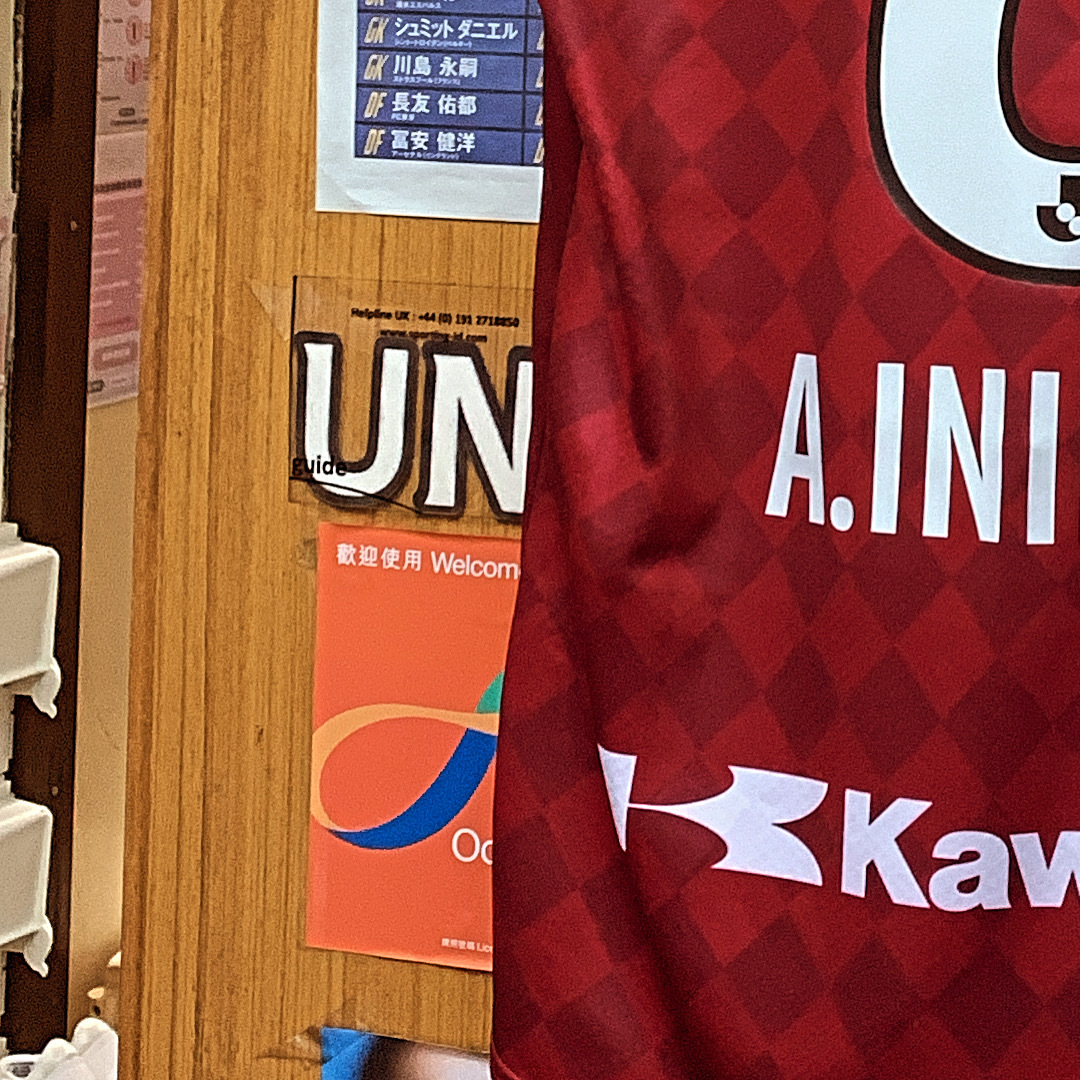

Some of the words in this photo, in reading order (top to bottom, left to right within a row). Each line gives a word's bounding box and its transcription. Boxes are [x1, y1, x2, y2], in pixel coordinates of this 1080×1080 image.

[394, 17, 455, 39] シュミット
[457, 19, 519, 40] ダニエル
[392, 54, 432, 77] 川島
[391, 91, 431, 114] 長友
[437, 93, 478, 116] 佑都
[436, 130, 476, 154] 健洋
[291, 455, 348, 478] guide
[430, 550, 522, 581] Welcom
